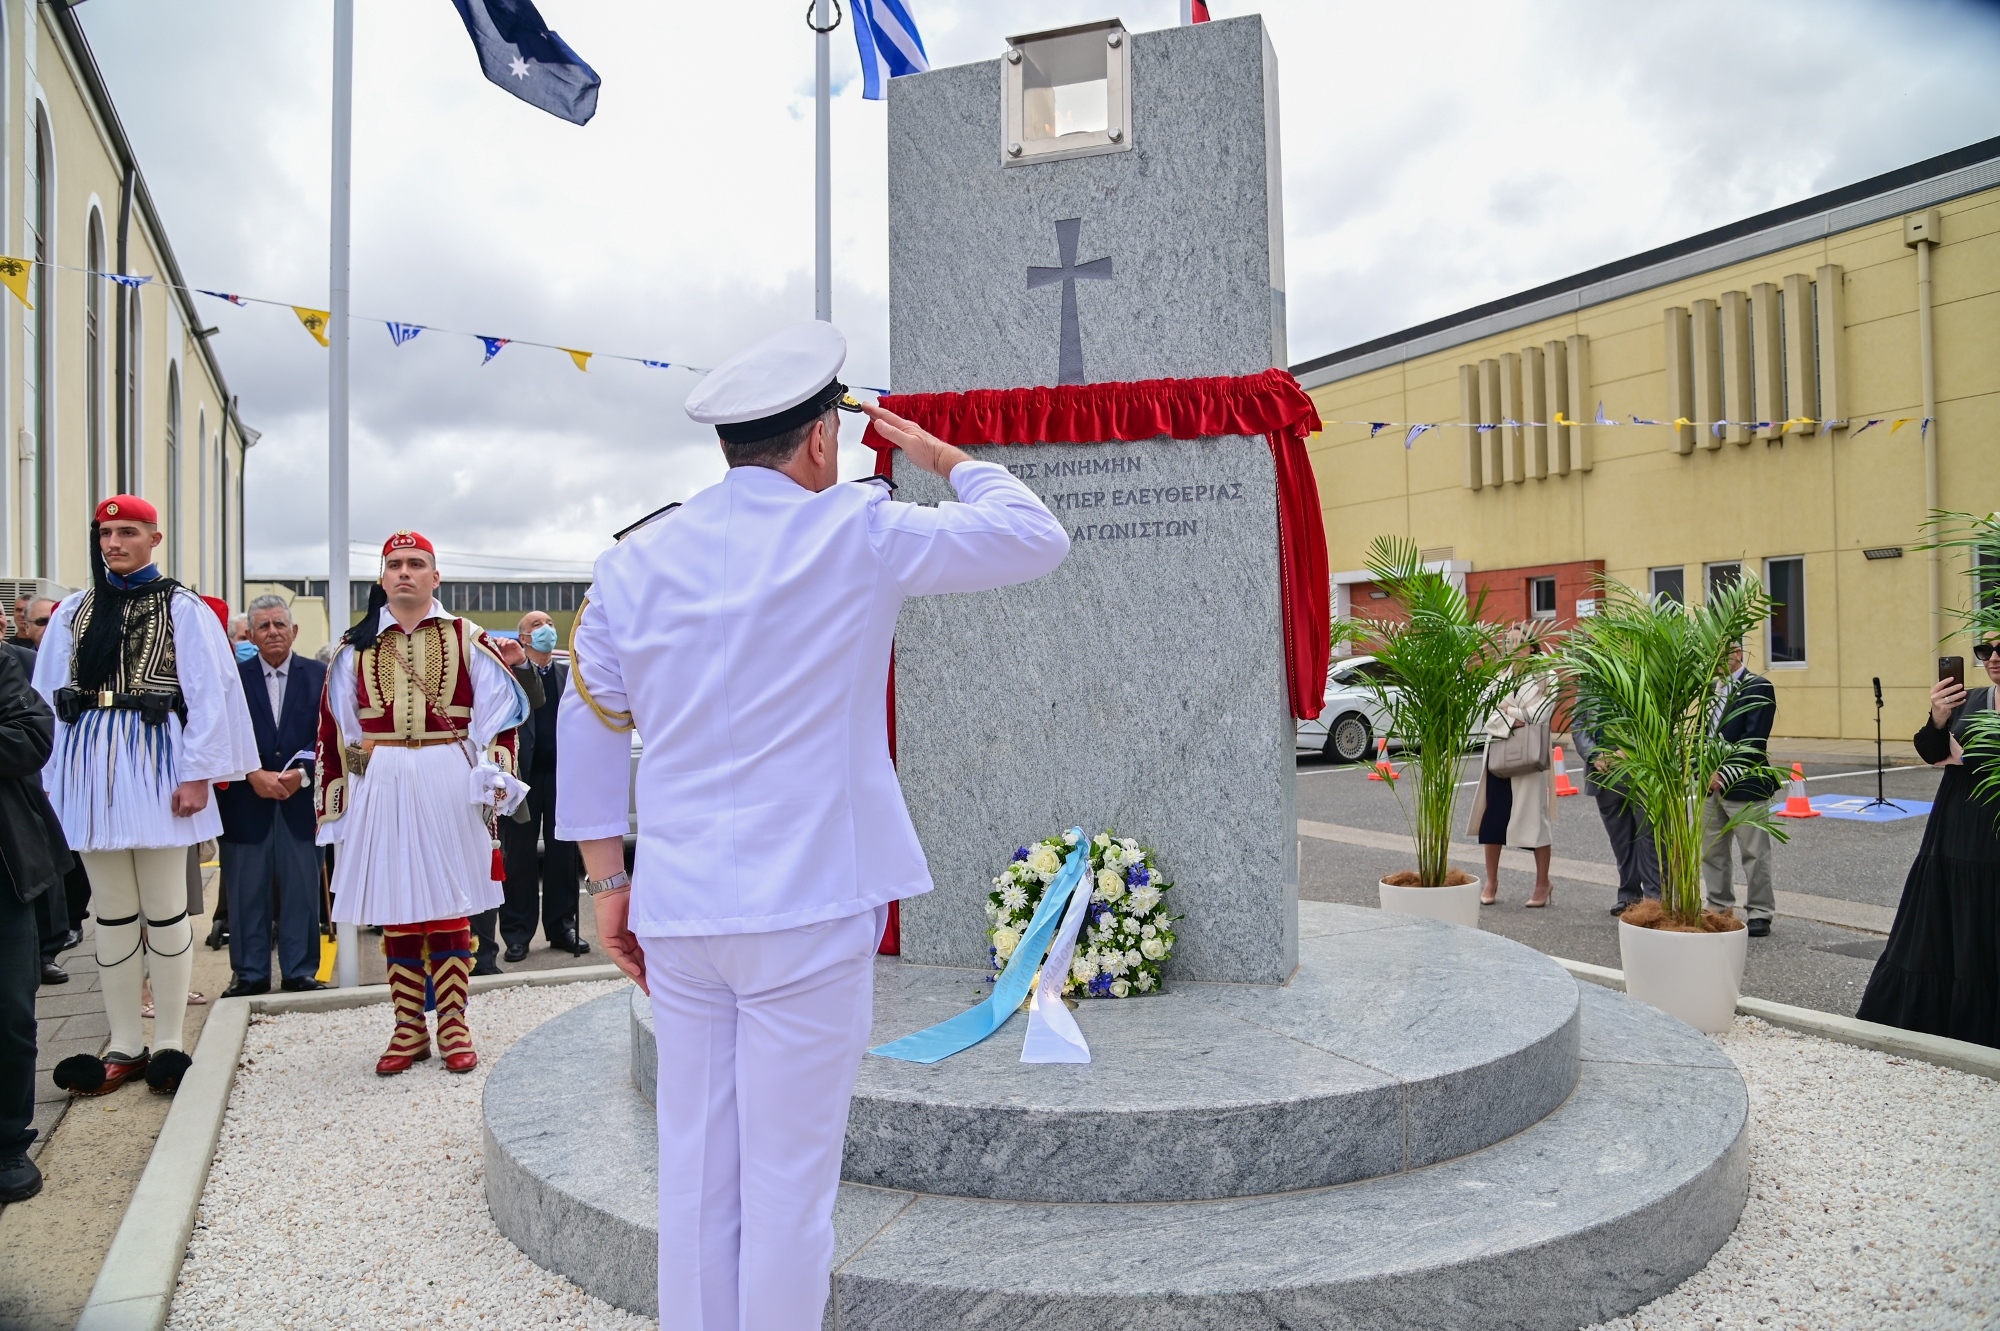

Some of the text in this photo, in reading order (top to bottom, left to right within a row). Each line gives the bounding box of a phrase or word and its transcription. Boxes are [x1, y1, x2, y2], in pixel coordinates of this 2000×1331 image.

[1044, 456, 1142, 478] ΜΝΗΜΗΝ
[1053, 491, 1106, 510] ΥΠΕΡ
[1112, 483, 1243, 506] ΕΛΕΥΘΕΡΙΑΣ
[1072, 519, 1198, 543] ΑΓΩΝΙΣΤΩΝ
